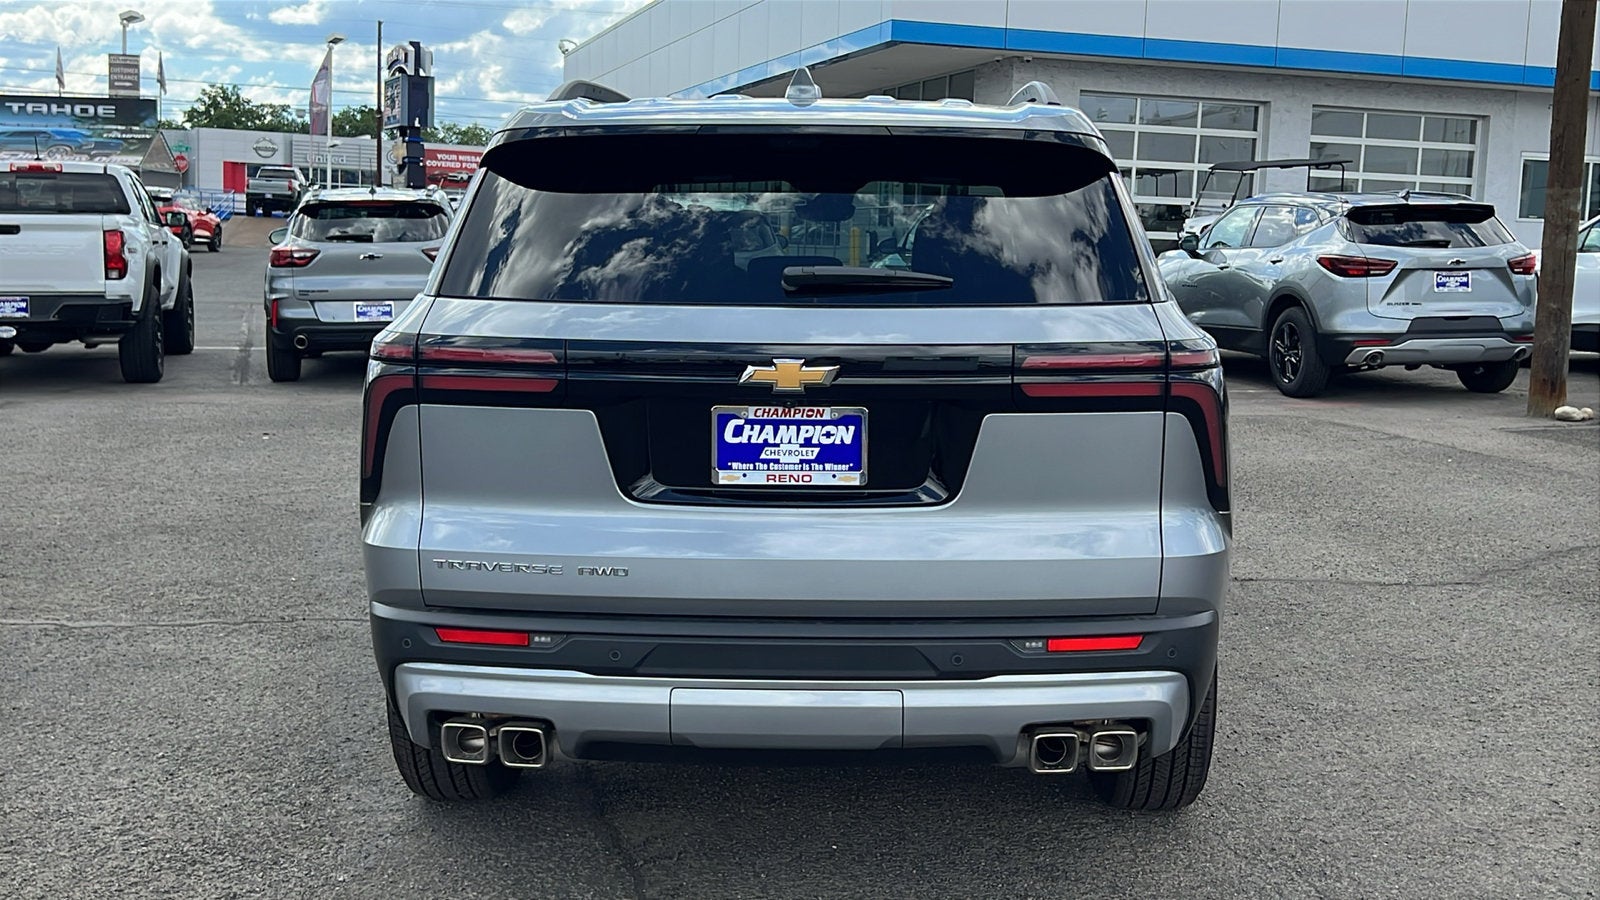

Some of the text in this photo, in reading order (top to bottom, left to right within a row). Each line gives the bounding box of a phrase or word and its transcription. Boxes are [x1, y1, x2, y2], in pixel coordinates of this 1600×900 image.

[4, 102, 116, 118] TAHOE
[306, 152, 346, 164] Unied
[436, 153, 481, 163] YOUR NISSA
[426, 160, 461, 169] COVERED
[357, 305, 391, 313] CHAMPION
[753, 407, 826, 418] CHAMPION
[723, 418, 856, 445] CHAMPION
[764, 449, 815, 457] CHEVROLET
[755, 462, 768, 471] The
[769, 462, 802, 471] Customer
[811, 463, 824, 471] The
[766, 474, 813, 483] RENO
[433, 558, 629, 577] TRAVERSE AWD
